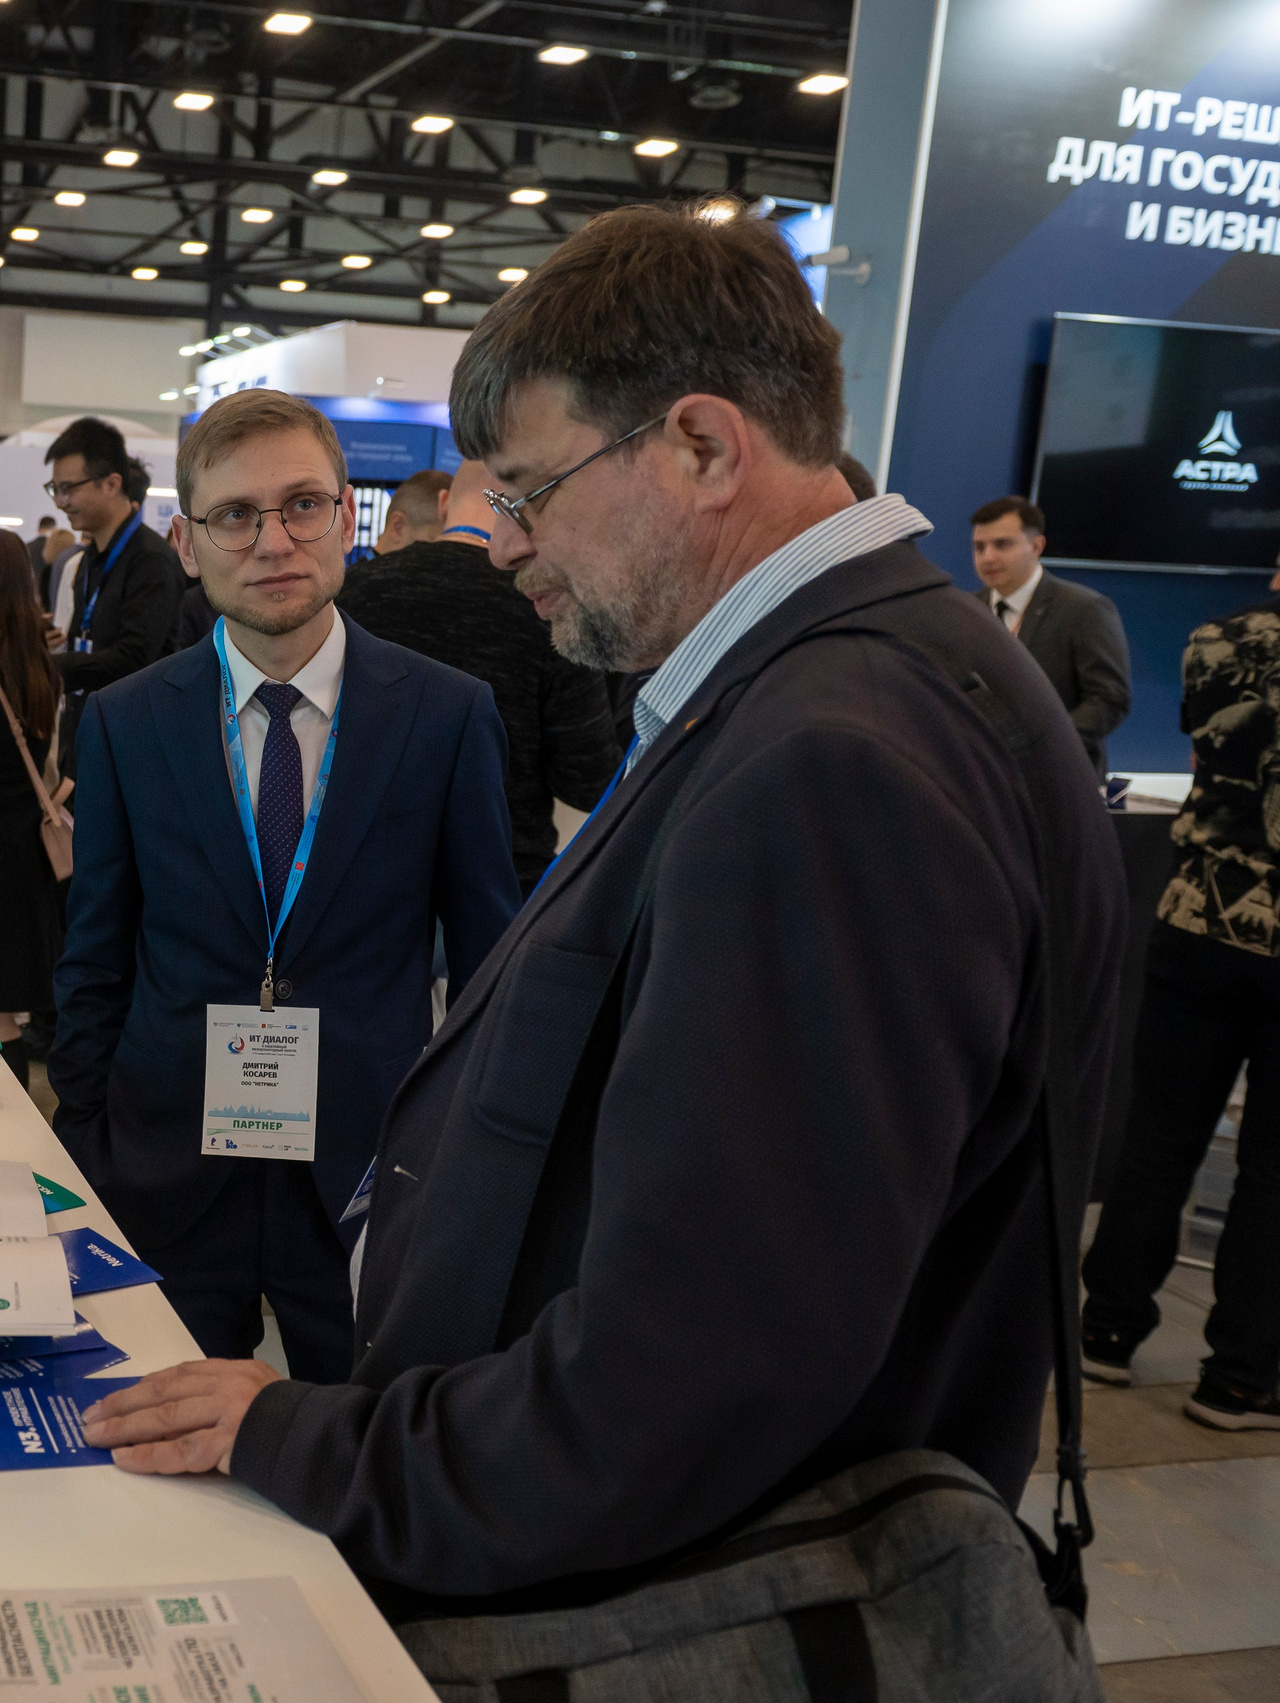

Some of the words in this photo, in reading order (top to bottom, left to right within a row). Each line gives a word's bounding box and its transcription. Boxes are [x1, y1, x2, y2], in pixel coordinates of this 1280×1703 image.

[1047, 136, 1144, 186] ДЛЯ
[1125, 201, 1160, 242] И
[1172, 459, 1259, 483] АСТРА
[241, 1062, 279, 1070] ДМИТРИЙ
[243, 1070, 278, 1078] КОСАРЕВ
[232, 1119, 283, 1131] ПАРТНЕР
[17, 1426, 45, 1454] N3.
